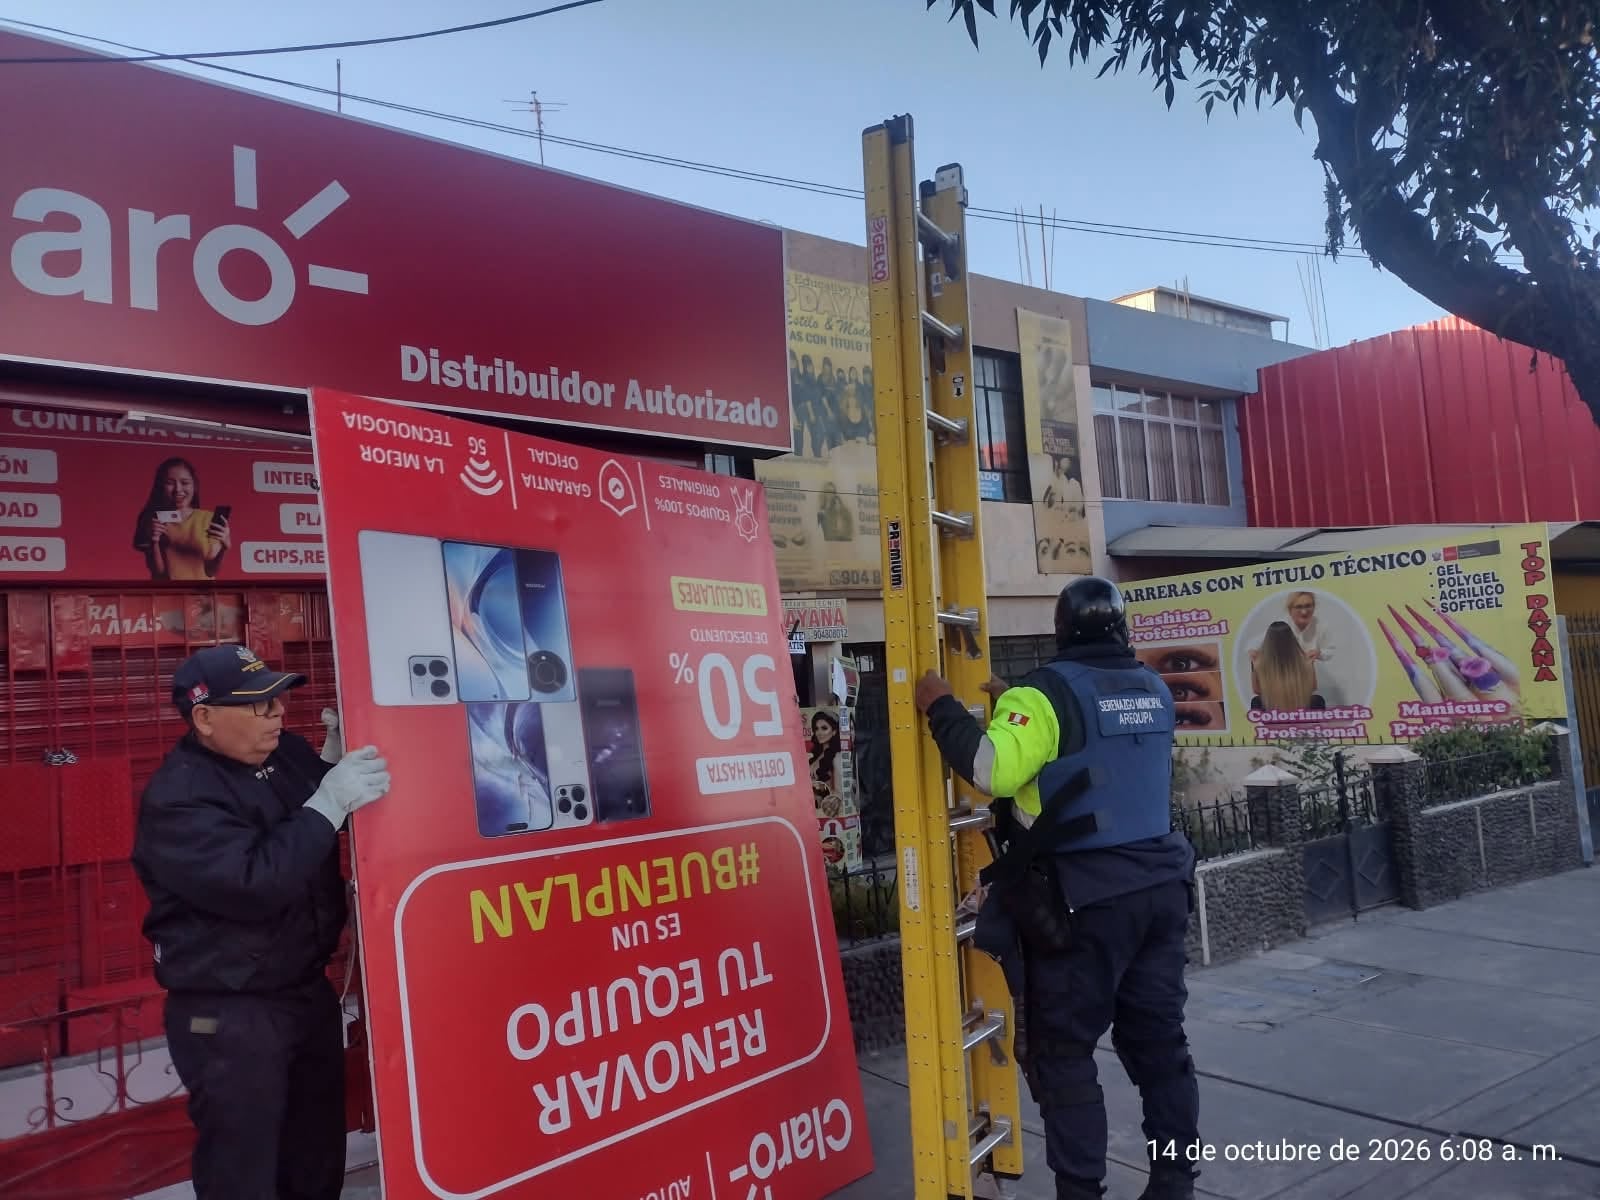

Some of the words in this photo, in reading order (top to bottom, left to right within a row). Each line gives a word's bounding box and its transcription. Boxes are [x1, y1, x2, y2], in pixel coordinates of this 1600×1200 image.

[400, 345, 615, 407] Distribuidor
[624, 379, 779, 429] Autorizado
[12, 408, 168, 437] CONTRA
[341, 411, 454, 448] TECNOLOGIA
[468, 435, 487, 456] 5G
[360, 444, 416, 472] MEJOR
[420, 455, 445, 475] LA
[528, 446, 579, 471] OFICIAL
[521, 471, 592, 499] GARANTIA
[659, 474, 721, 499] ORIGINALES
[655, 497, 684, 515] 100%
[686, 501, 731, 523] EQUIPOS
[0, 545, 47, 562] AGO
[1520, 541, 1546, 587] TOP
[1206, 574, 1244, 593] CON
[1253, 562, 1326, 588] TÍTULO
[1330, 548, 1427, 577] TÉCNICO
[1436, 564, 1463, 577] GEL
[1438, 571, 1500, 589] POLYGEL
[678, 582, 744, 609] CELULARES
[746, 588, 762, 610] EN
[1439, 583, 1505, 602] ACRILICO
[1440, 597, 1503, 613] SOFTGEL
[1133, 608, 1211, 628] Lashista
[690, 628, 752, 644] DESCUENTO
[754, 631, 768, 644] DE
[1526, 594, 1558, 682] DAYANA
[1099, 698, 1136, 712] SERENAZGO
[1248, 704, 1373, 722] Colorimetria
[1401, 701, 1508, 717] Manicure
[1119, 712, 1154, 726] AREQUIPA
[706, 761, 745, 784] HASTA
[469, 841, 761, 944] #BUENPLAN
[612, 919, 650, 951] UN
[656, 912, 681, 940] ES
[717, 941, 774, 997] TU
[506, 957, 705, 1062] EQUIPO
[532, 1008, 768, 1135] RENOVAR
[747, 1098, 853, 1181] Claro
